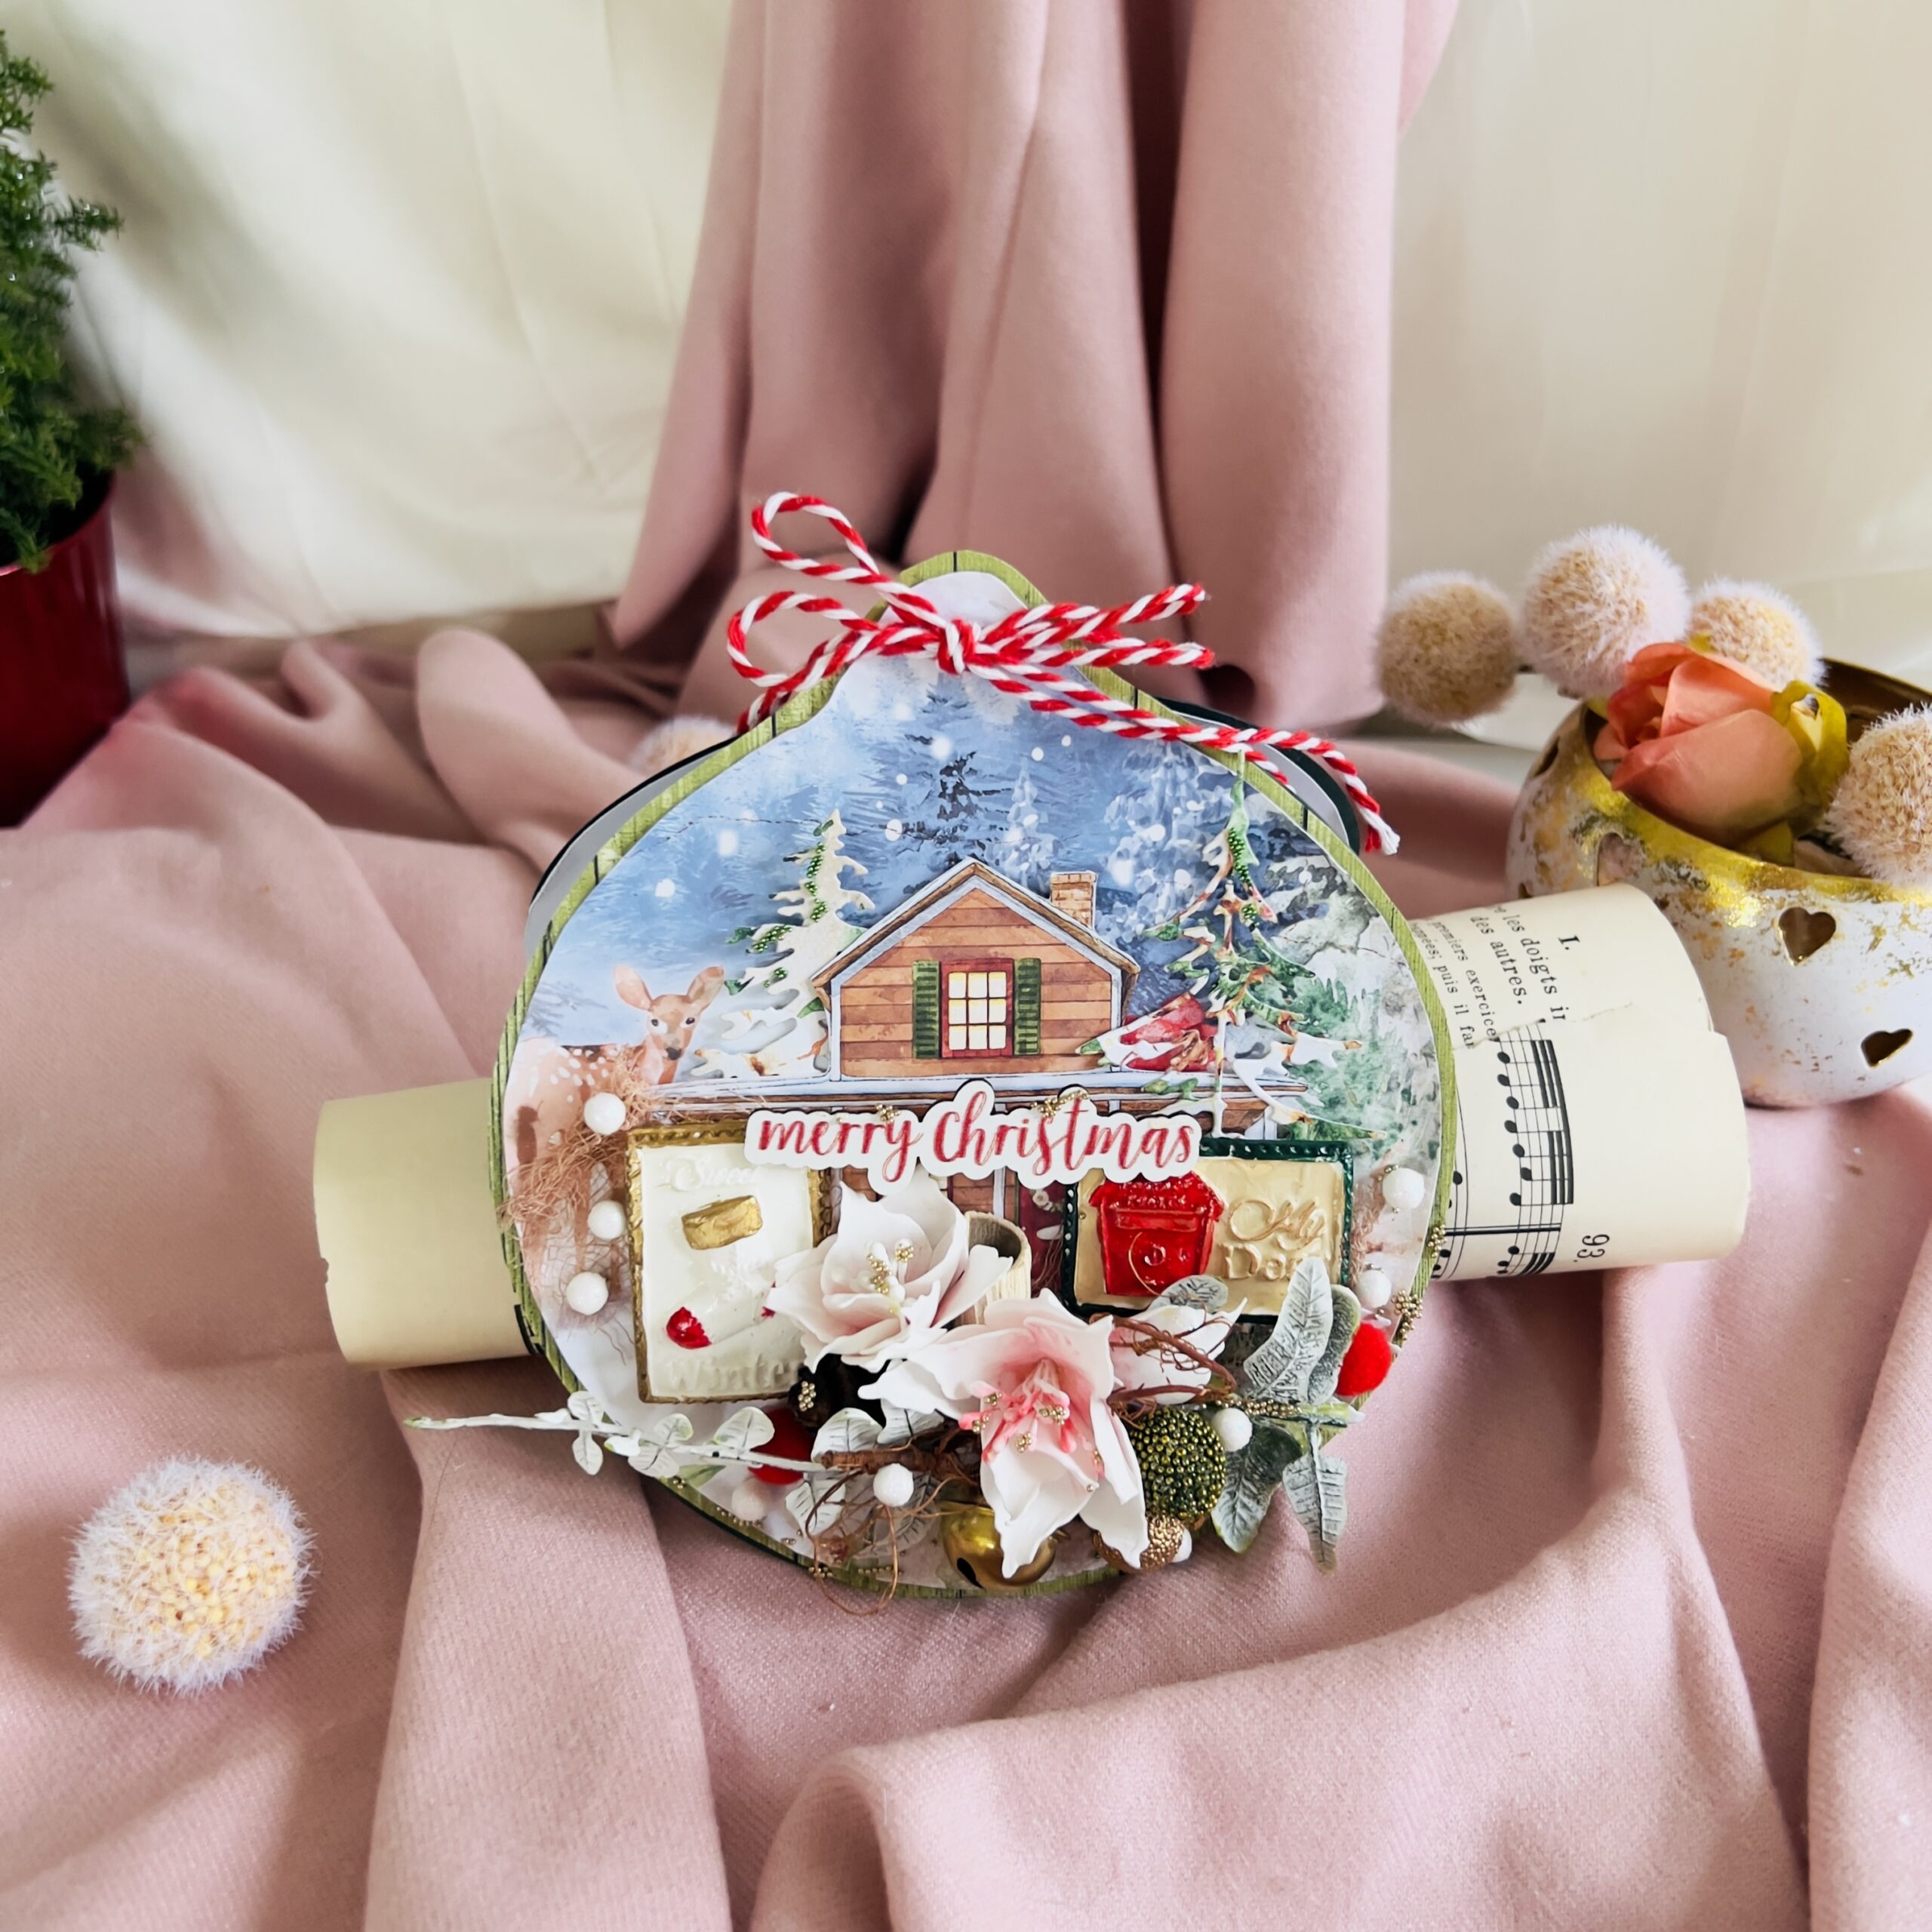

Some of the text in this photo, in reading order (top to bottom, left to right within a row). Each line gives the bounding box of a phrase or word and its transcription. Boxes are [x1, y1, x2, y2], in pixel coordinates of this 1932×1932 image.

[1490, 940, 1527, 1004] autres.
[1503, 914, 1525, 933] les
[1520, 937, 1558, 995] doigts
[1432, 964, 1459, 995] puis
[1453, 1004, 1469, 1015] il
[758, 1115, 923, 1183] merry
